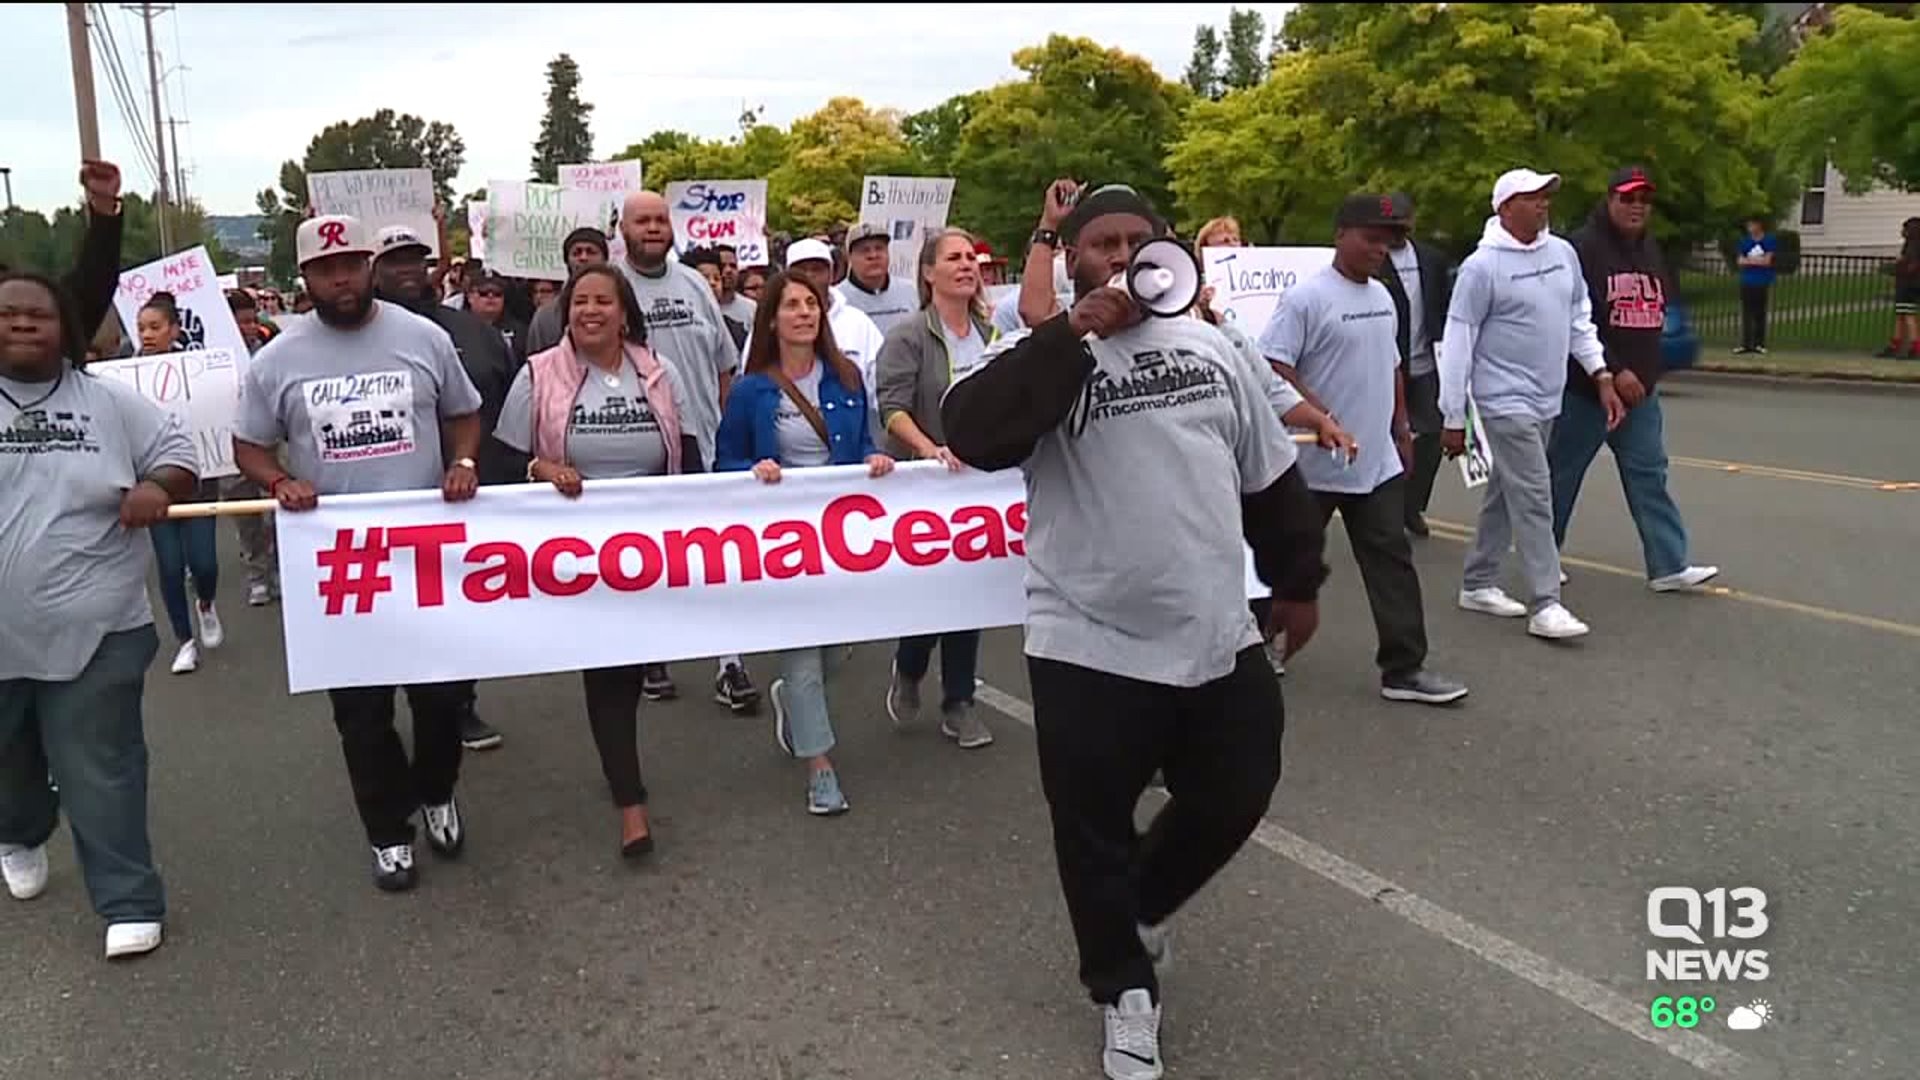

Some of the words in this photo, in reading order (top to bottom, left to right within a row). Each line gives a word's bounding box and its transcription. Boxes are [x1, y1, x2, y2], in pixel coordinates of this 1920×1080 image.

[868, 181, 886, 204] Be
[318, 222, 349, 249] R
[1214, 254, 1297, 291] Tacoma
